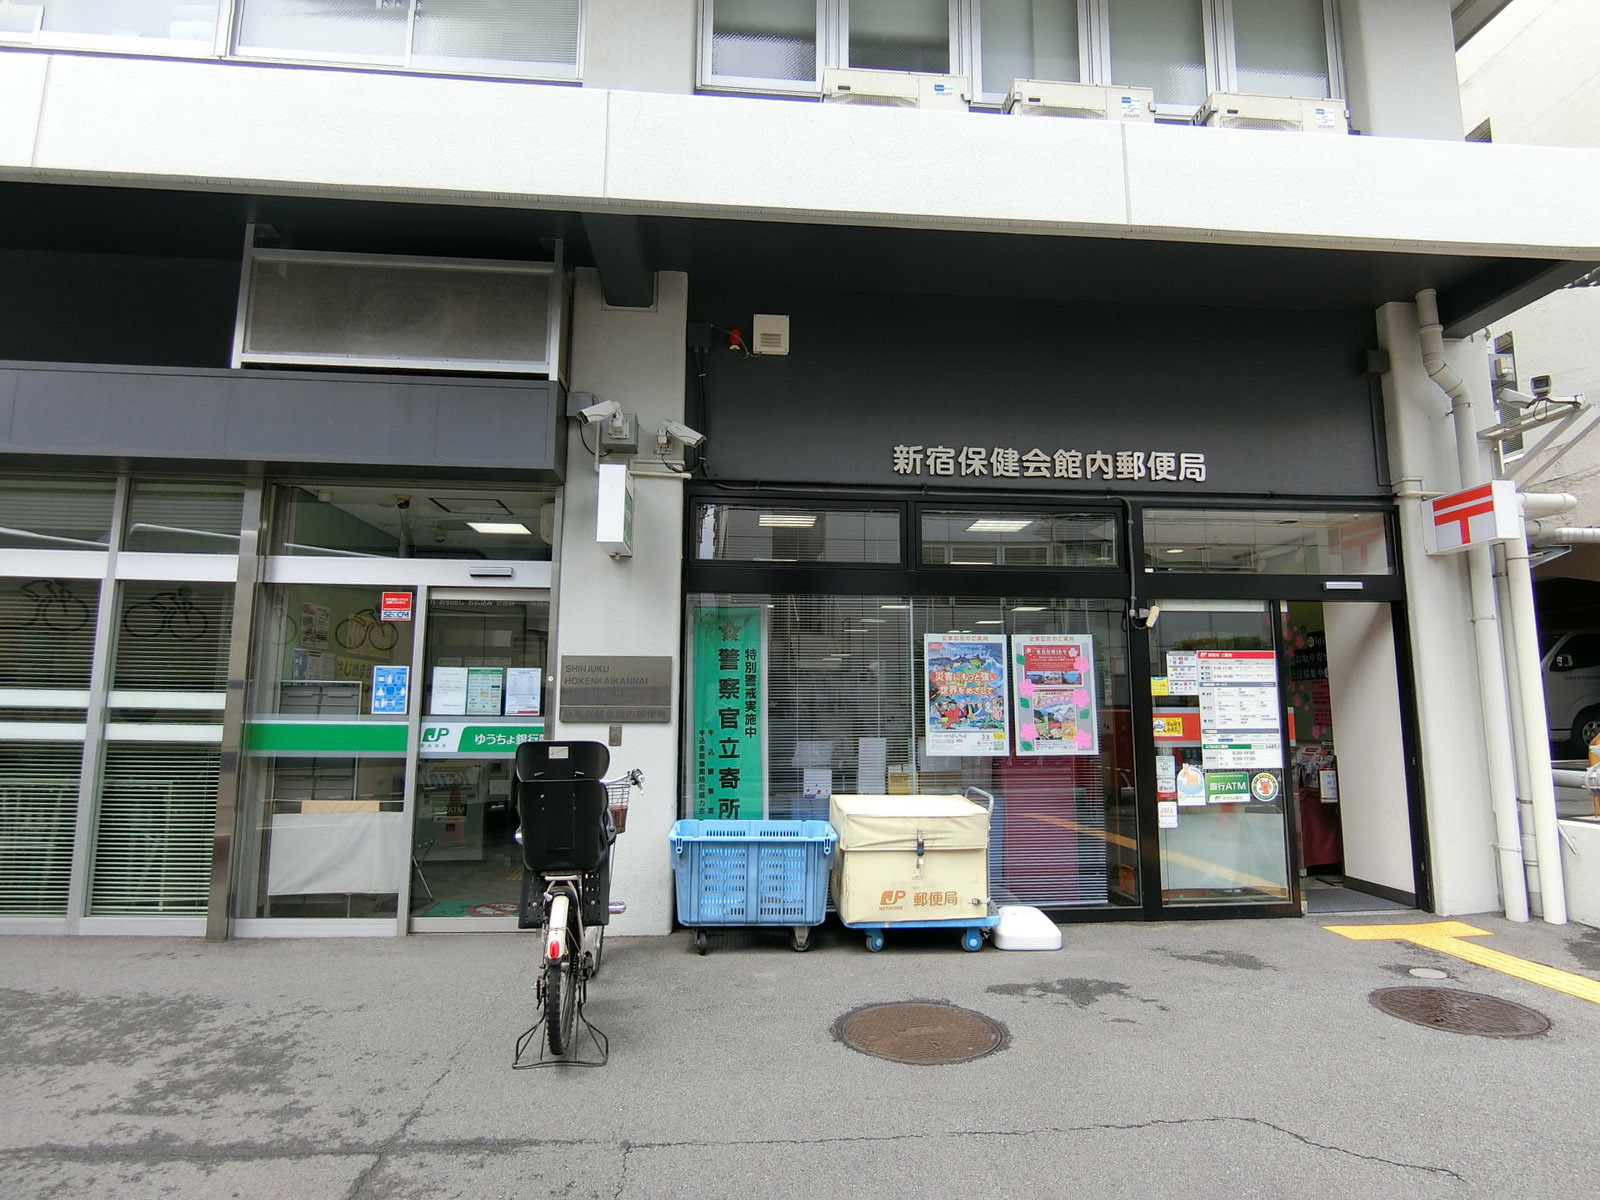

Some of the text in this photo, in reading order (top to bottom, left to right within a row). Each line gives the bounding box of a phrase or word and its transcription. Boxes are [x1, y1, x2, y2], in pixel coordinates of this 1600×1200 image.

[892, 444, 1207, 482] 新宿保健会館内郵便局
[565, 664, 610, 673] SHINJUKU
[564, 677, 649, 685] HOKENKAIKANNAI
[934, 671, 997, 681] 災害にもっと強い
[744, 648, 757, 739] 特別警戒実施中
[940, 686, 995, 695] 世界をめざして
[422, 727, 450, 742] JP
[718, 648, 740, 819] 警察官立寄所
[1209, 781, 1247, 791] 銀行ATM
[880, 890, 958, 907] JP 郵便局
